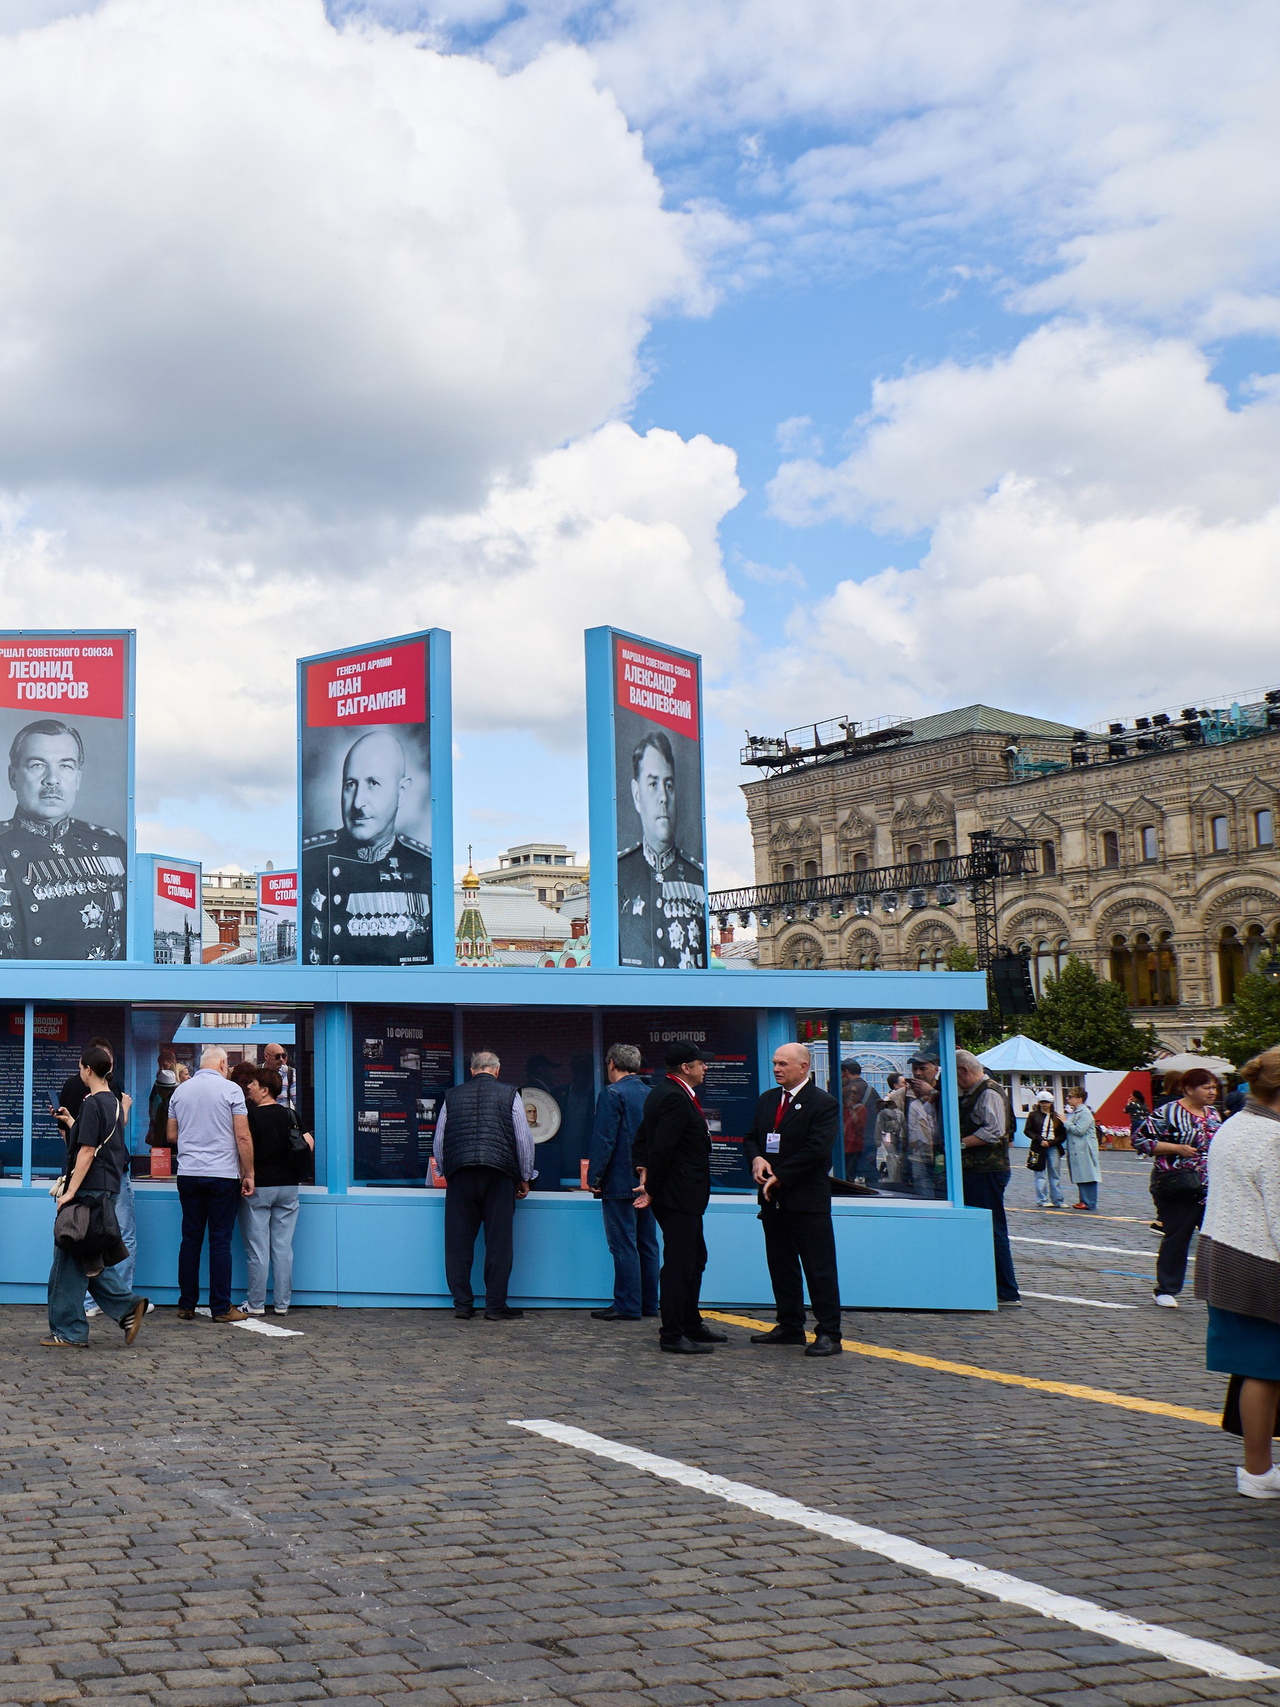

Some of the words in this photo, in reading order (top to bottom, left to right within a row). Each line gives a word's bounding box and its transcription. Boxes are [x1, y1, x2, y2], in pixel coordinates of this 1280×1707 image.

[26, 647, 80, 657] СОВЕТСКОГО
[82, 647, 113, 657] СОЮЗА
[8, 661, 74, 681] ЛЕОНИД
[336, 662, 366, 677] ГЕНЕРАЛ
[367, 656, 393, 671] АРМИИ
[622, 649, 645, 665] МАРШАЛ
[645, 656, 674, 674] СОВЕТСКОГО
[675, 665, 691, 679] СОЮЗА
[328, 676, 362, 699] ИВАН
[624, 663, 677, 696] АЛЕКСАНДР
[17, 681, 89, 700] ГОВОРОВ
[337, 687, 406, 718] БАГРАМЯН
[629, 686, 691, 720] ВАСИЛЕВСКИЙ
[163, 873, 181, 886] ОБЛИК
[269, 878, 293, 890] ОБЛИК
[167, 885, 193, 900] СТОЛИЦЫ
[275, 889, 298, 901] СТОЛИ
[14, 1017, 63, 1026] ПООВОДЦЫ
[386, 1027, 394, 1038] 10
[394, 1027, 424, 1040] ФРОНТОВ
[649, 1031, 660, 1042] 10
[661, 1031, 706, 1042] ФРОНТОВ
